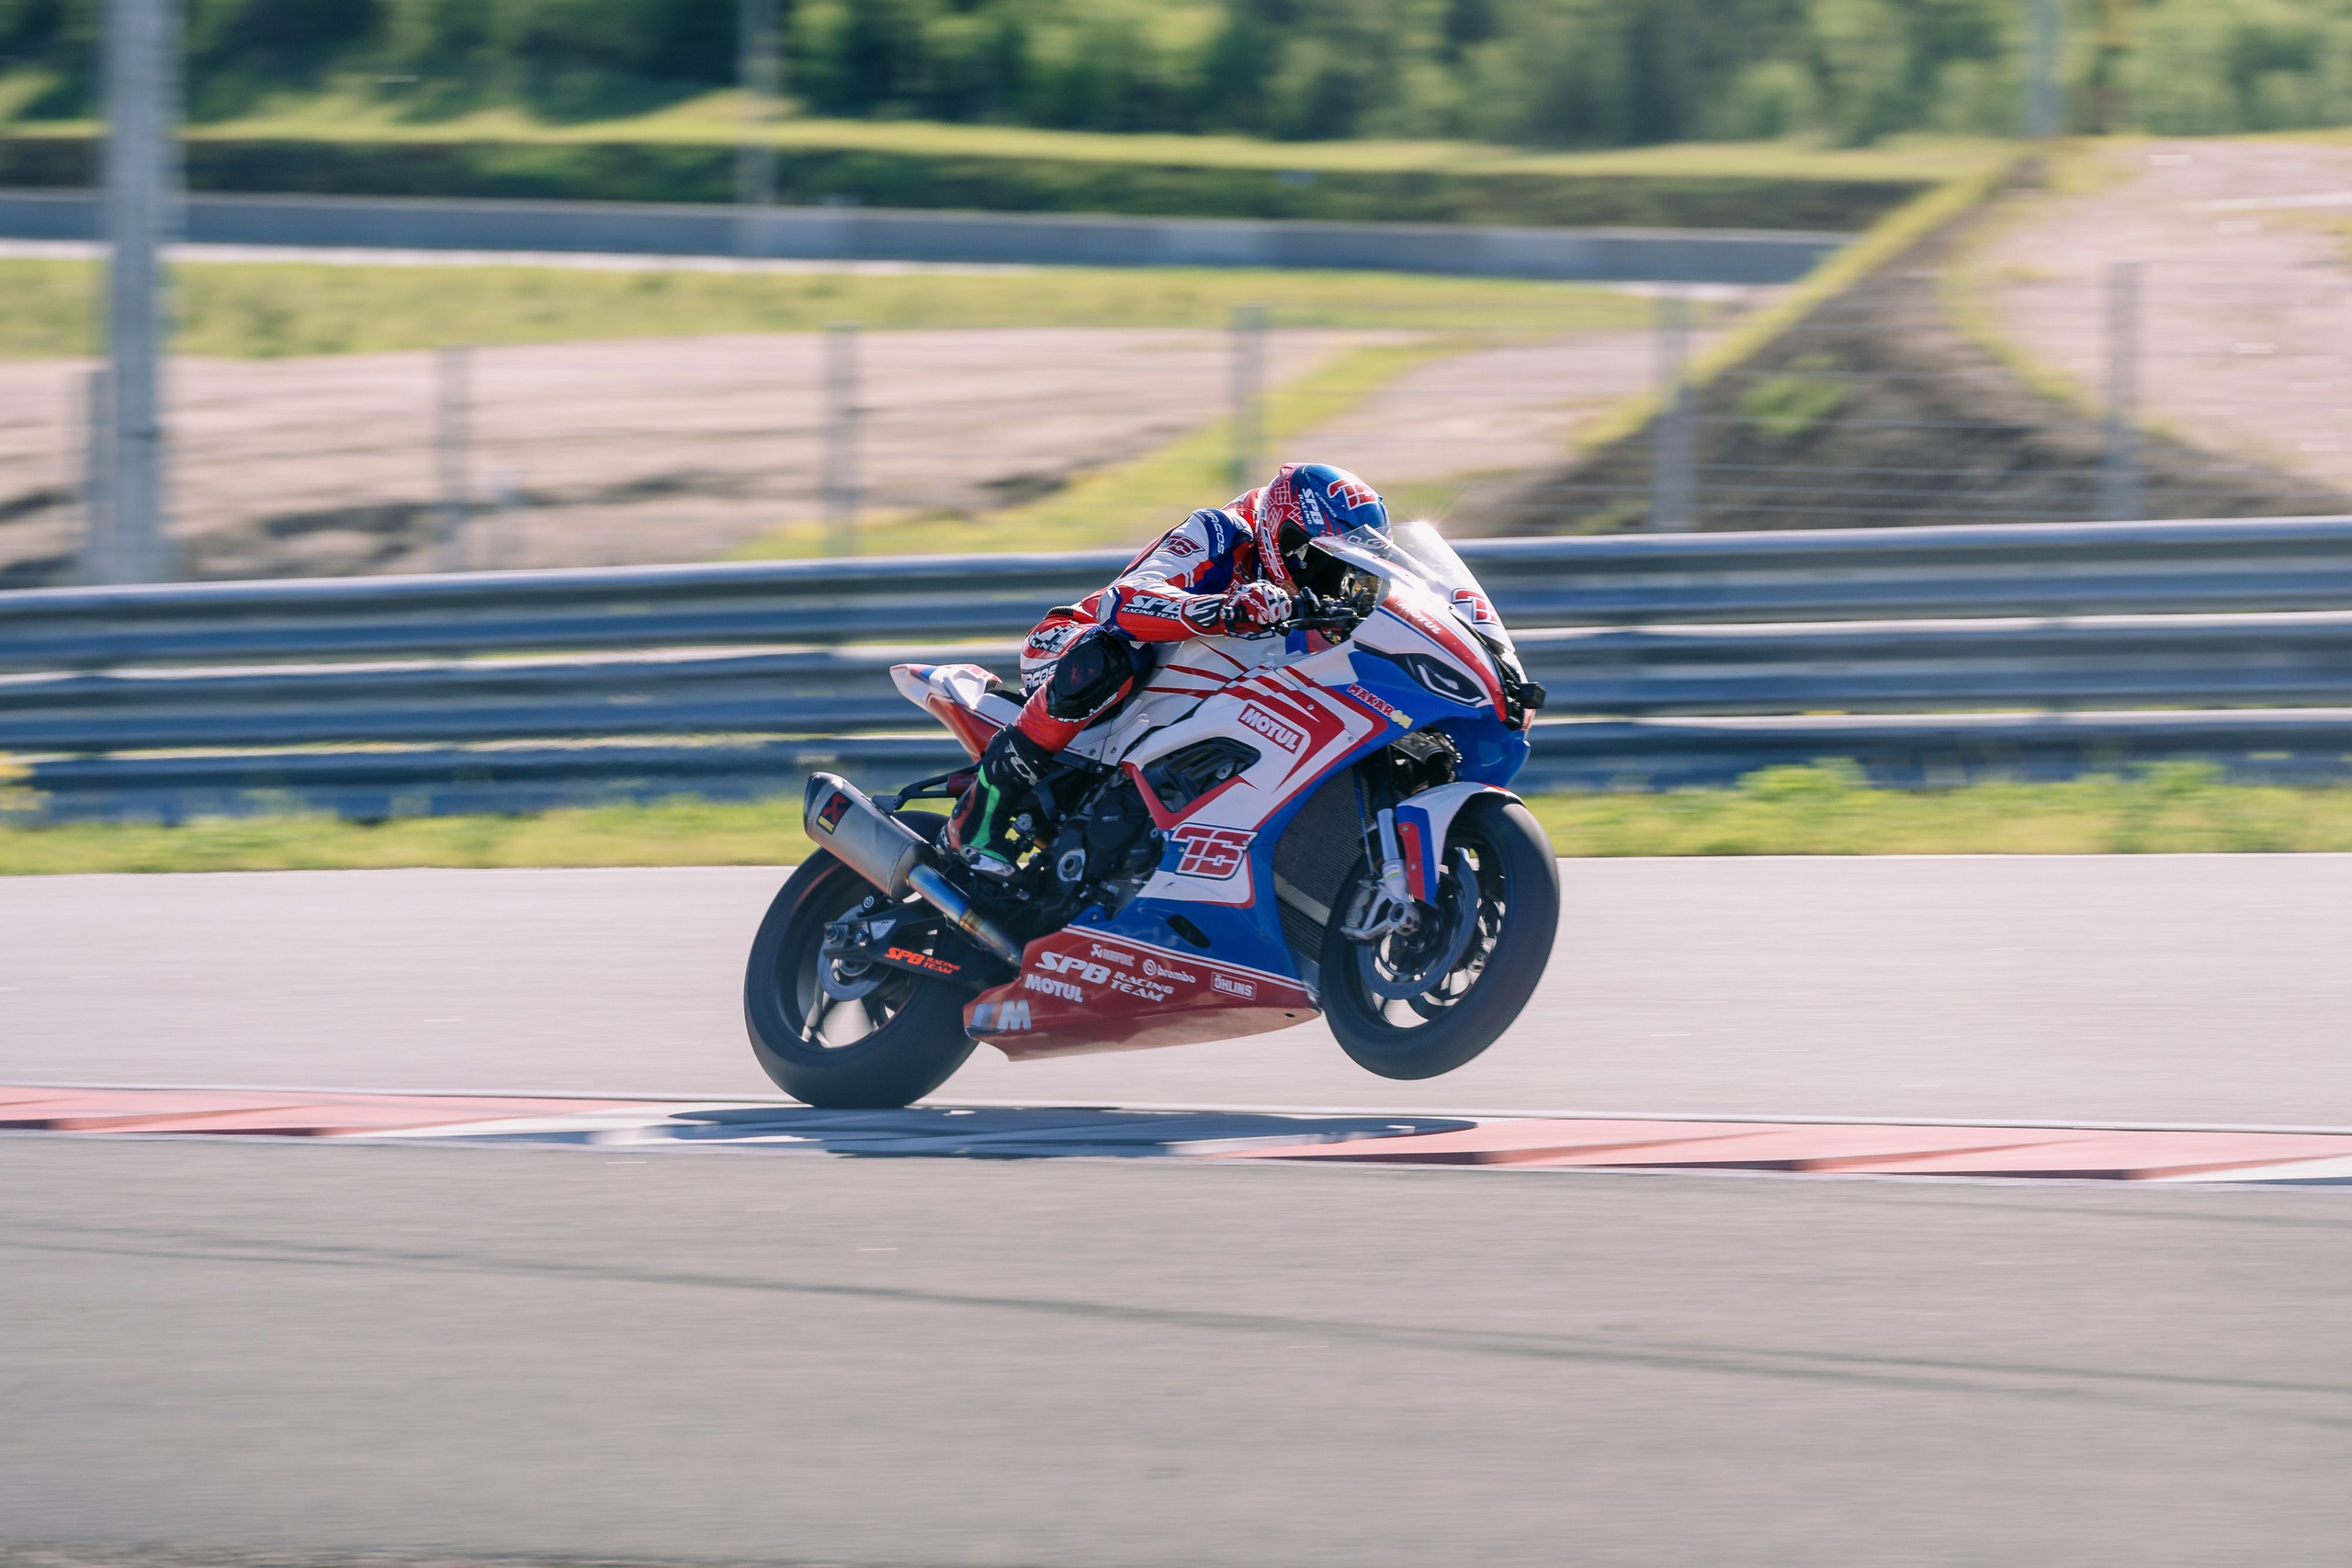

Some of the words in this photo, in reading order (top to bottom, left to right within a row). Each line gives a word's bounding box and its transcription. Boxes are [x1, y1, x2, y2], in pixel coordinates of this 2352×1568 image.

[1301, 488, 1325, 525] SPB
[1121, 606, 1155, 616] RACING
[1239, 707, 1300, 750] MOTUL
[885, 946, 925, 965] SPB
[1035, 951, 1112, 985] SPB
[1114, 971, 1174, 995] RACING
[1156, 964, 1196, 984] brembo
[1023, 973, 1084, 1003] MOTUL
[1110, 978, 1165, 1003] TEAM
